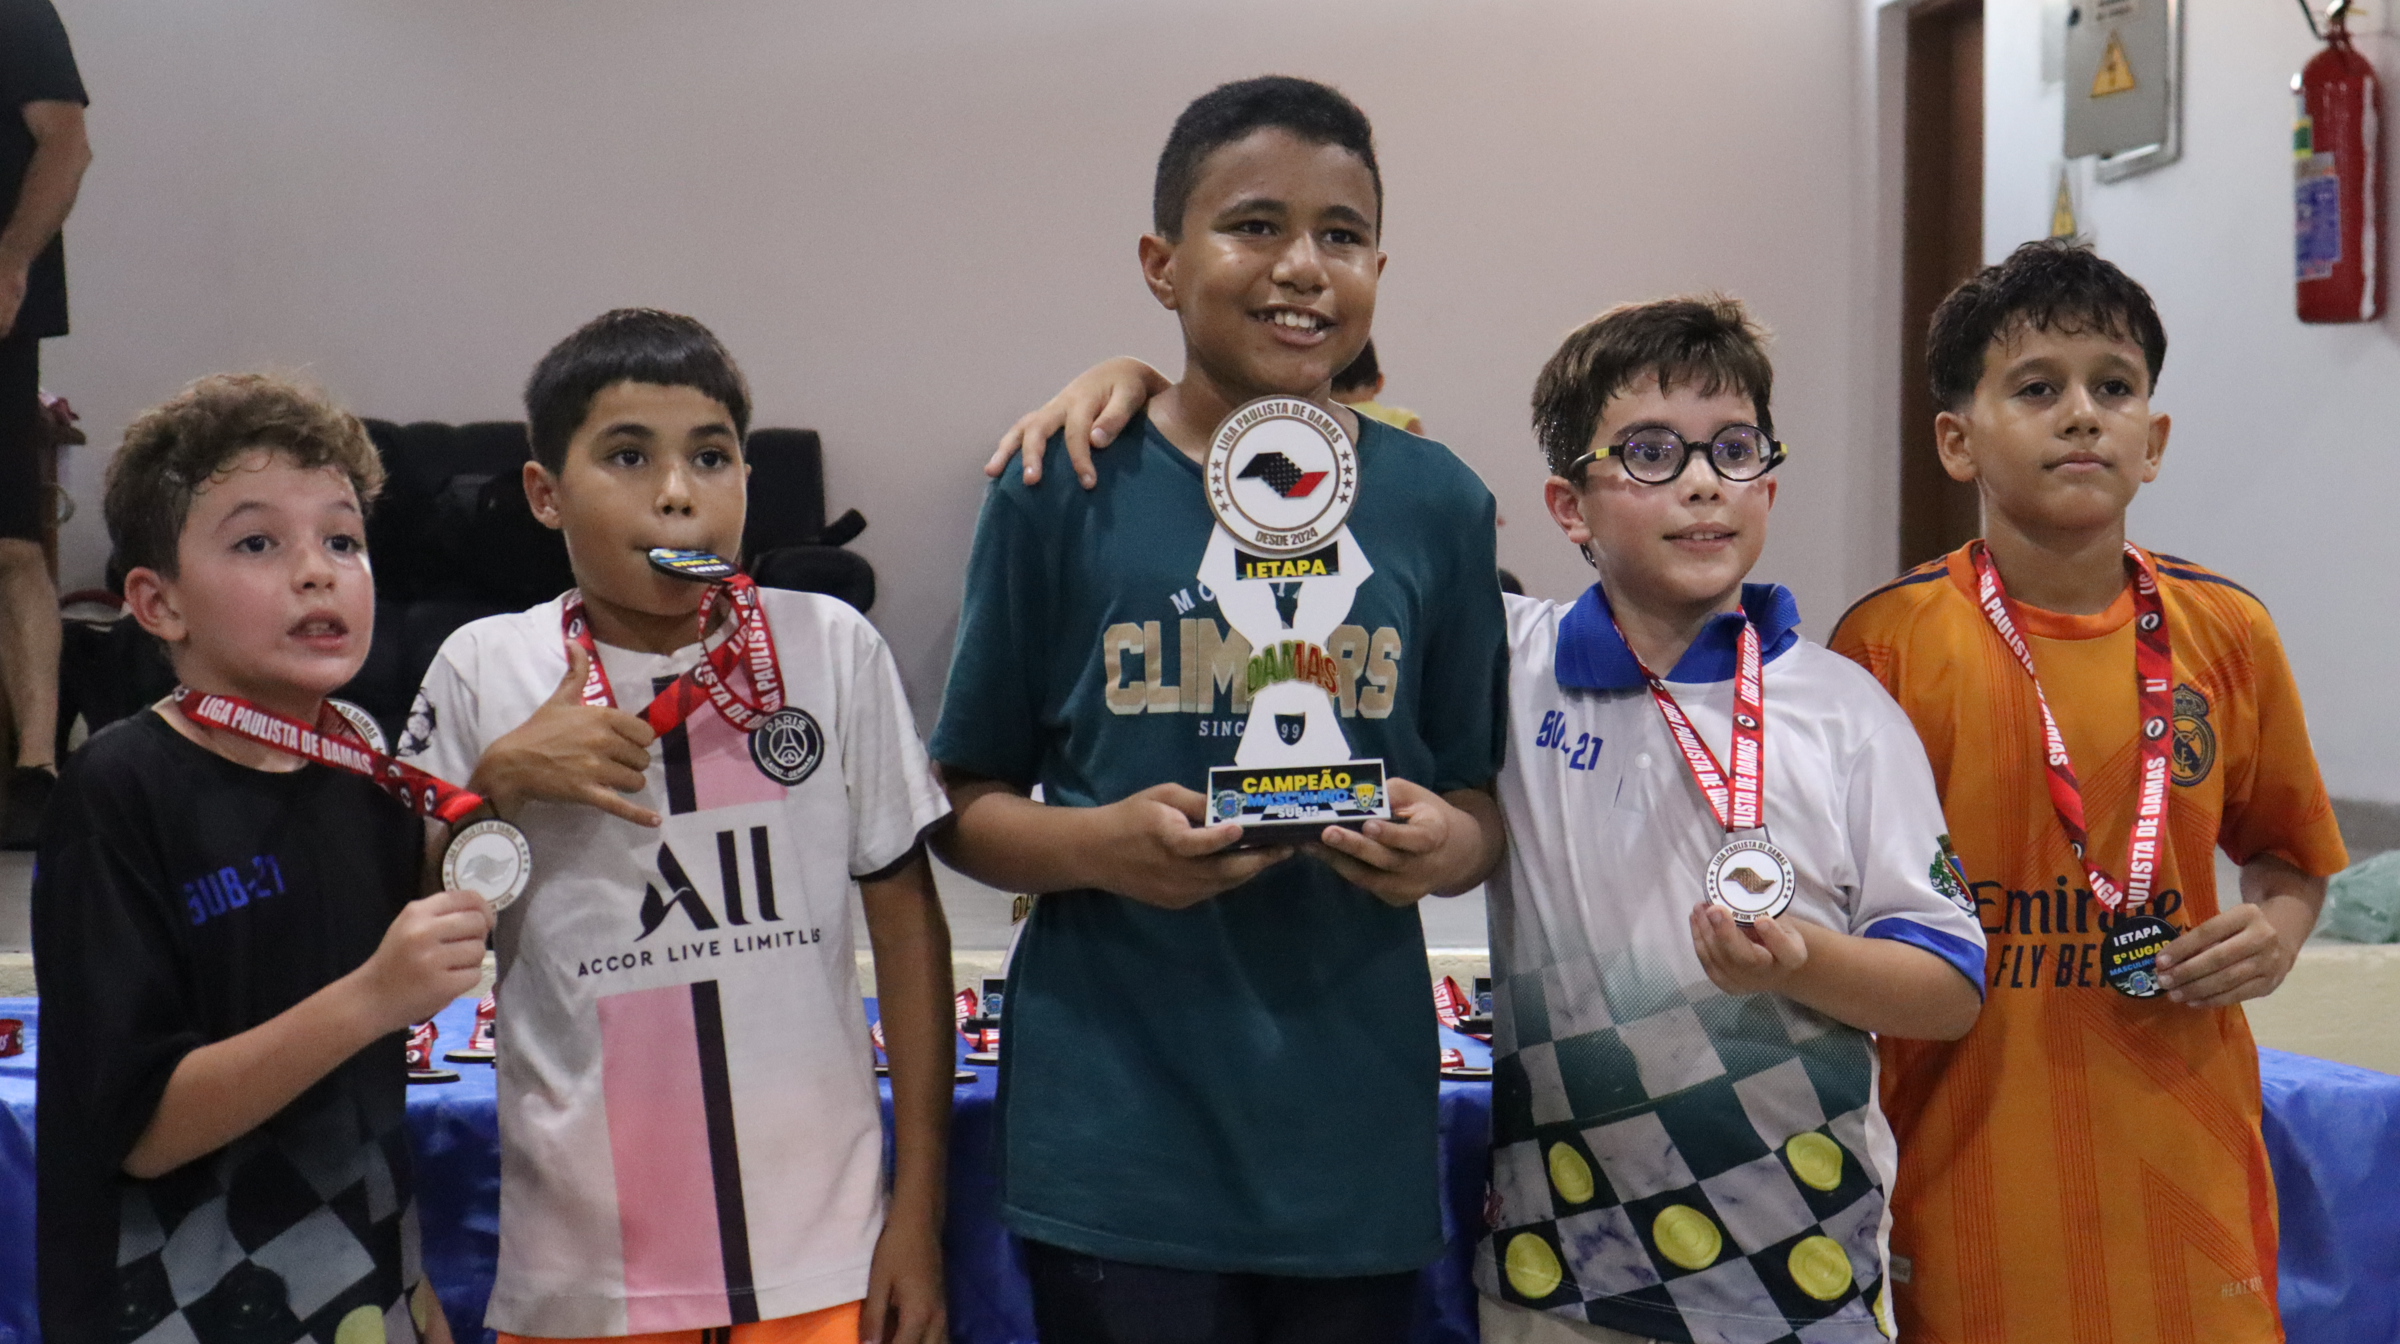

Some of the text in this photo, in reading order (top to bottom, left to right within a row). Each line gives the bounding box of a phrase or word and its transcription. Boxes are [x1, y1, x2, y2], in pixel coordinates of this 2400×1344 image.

[1216, 402, 1343, 451] LIGA PAULISTA DE DAMAS
[1255, 527, 1319, 547] DESDE 2024
[1256, 558, 1327, 579] ETAPA
[1984, 596, 2035, 676] PAULISTA
[1103, 618, 1402, 719] CLIMRS
[1246, 640, 1340, 701] DAMAS
[1741, 678, 1760, 707] LIGA
[765, 715, 808, 733] PARIS
[1658, 698, 1687, 726] LIGA
[196, 694, 374, 776] LIGA PAULISTA DE DAMAS
[1199, 720, 1247, 737] SINC
[1670, 722, 1716, 773] PAULISTA
[1736, 735, 1759, 777] DAMAS
[1241, 768, 1352, 794] CAMPEÃO
[1697, 772, 1725, 788] DE
[1734, 774, 1758, 792] DE
[2140, 756, 2167, 817] DAMAS
[1246, 788, 1350, 807] MASCULINO
[2135, 817, 2159, 837] DE
[2119, 924, 2162, 946] ETAPA
[577, 951, 654, 978] ACCOR
[668, 940, 722, 963] LIVE
[1993, 943, 2048, 989] FLY
